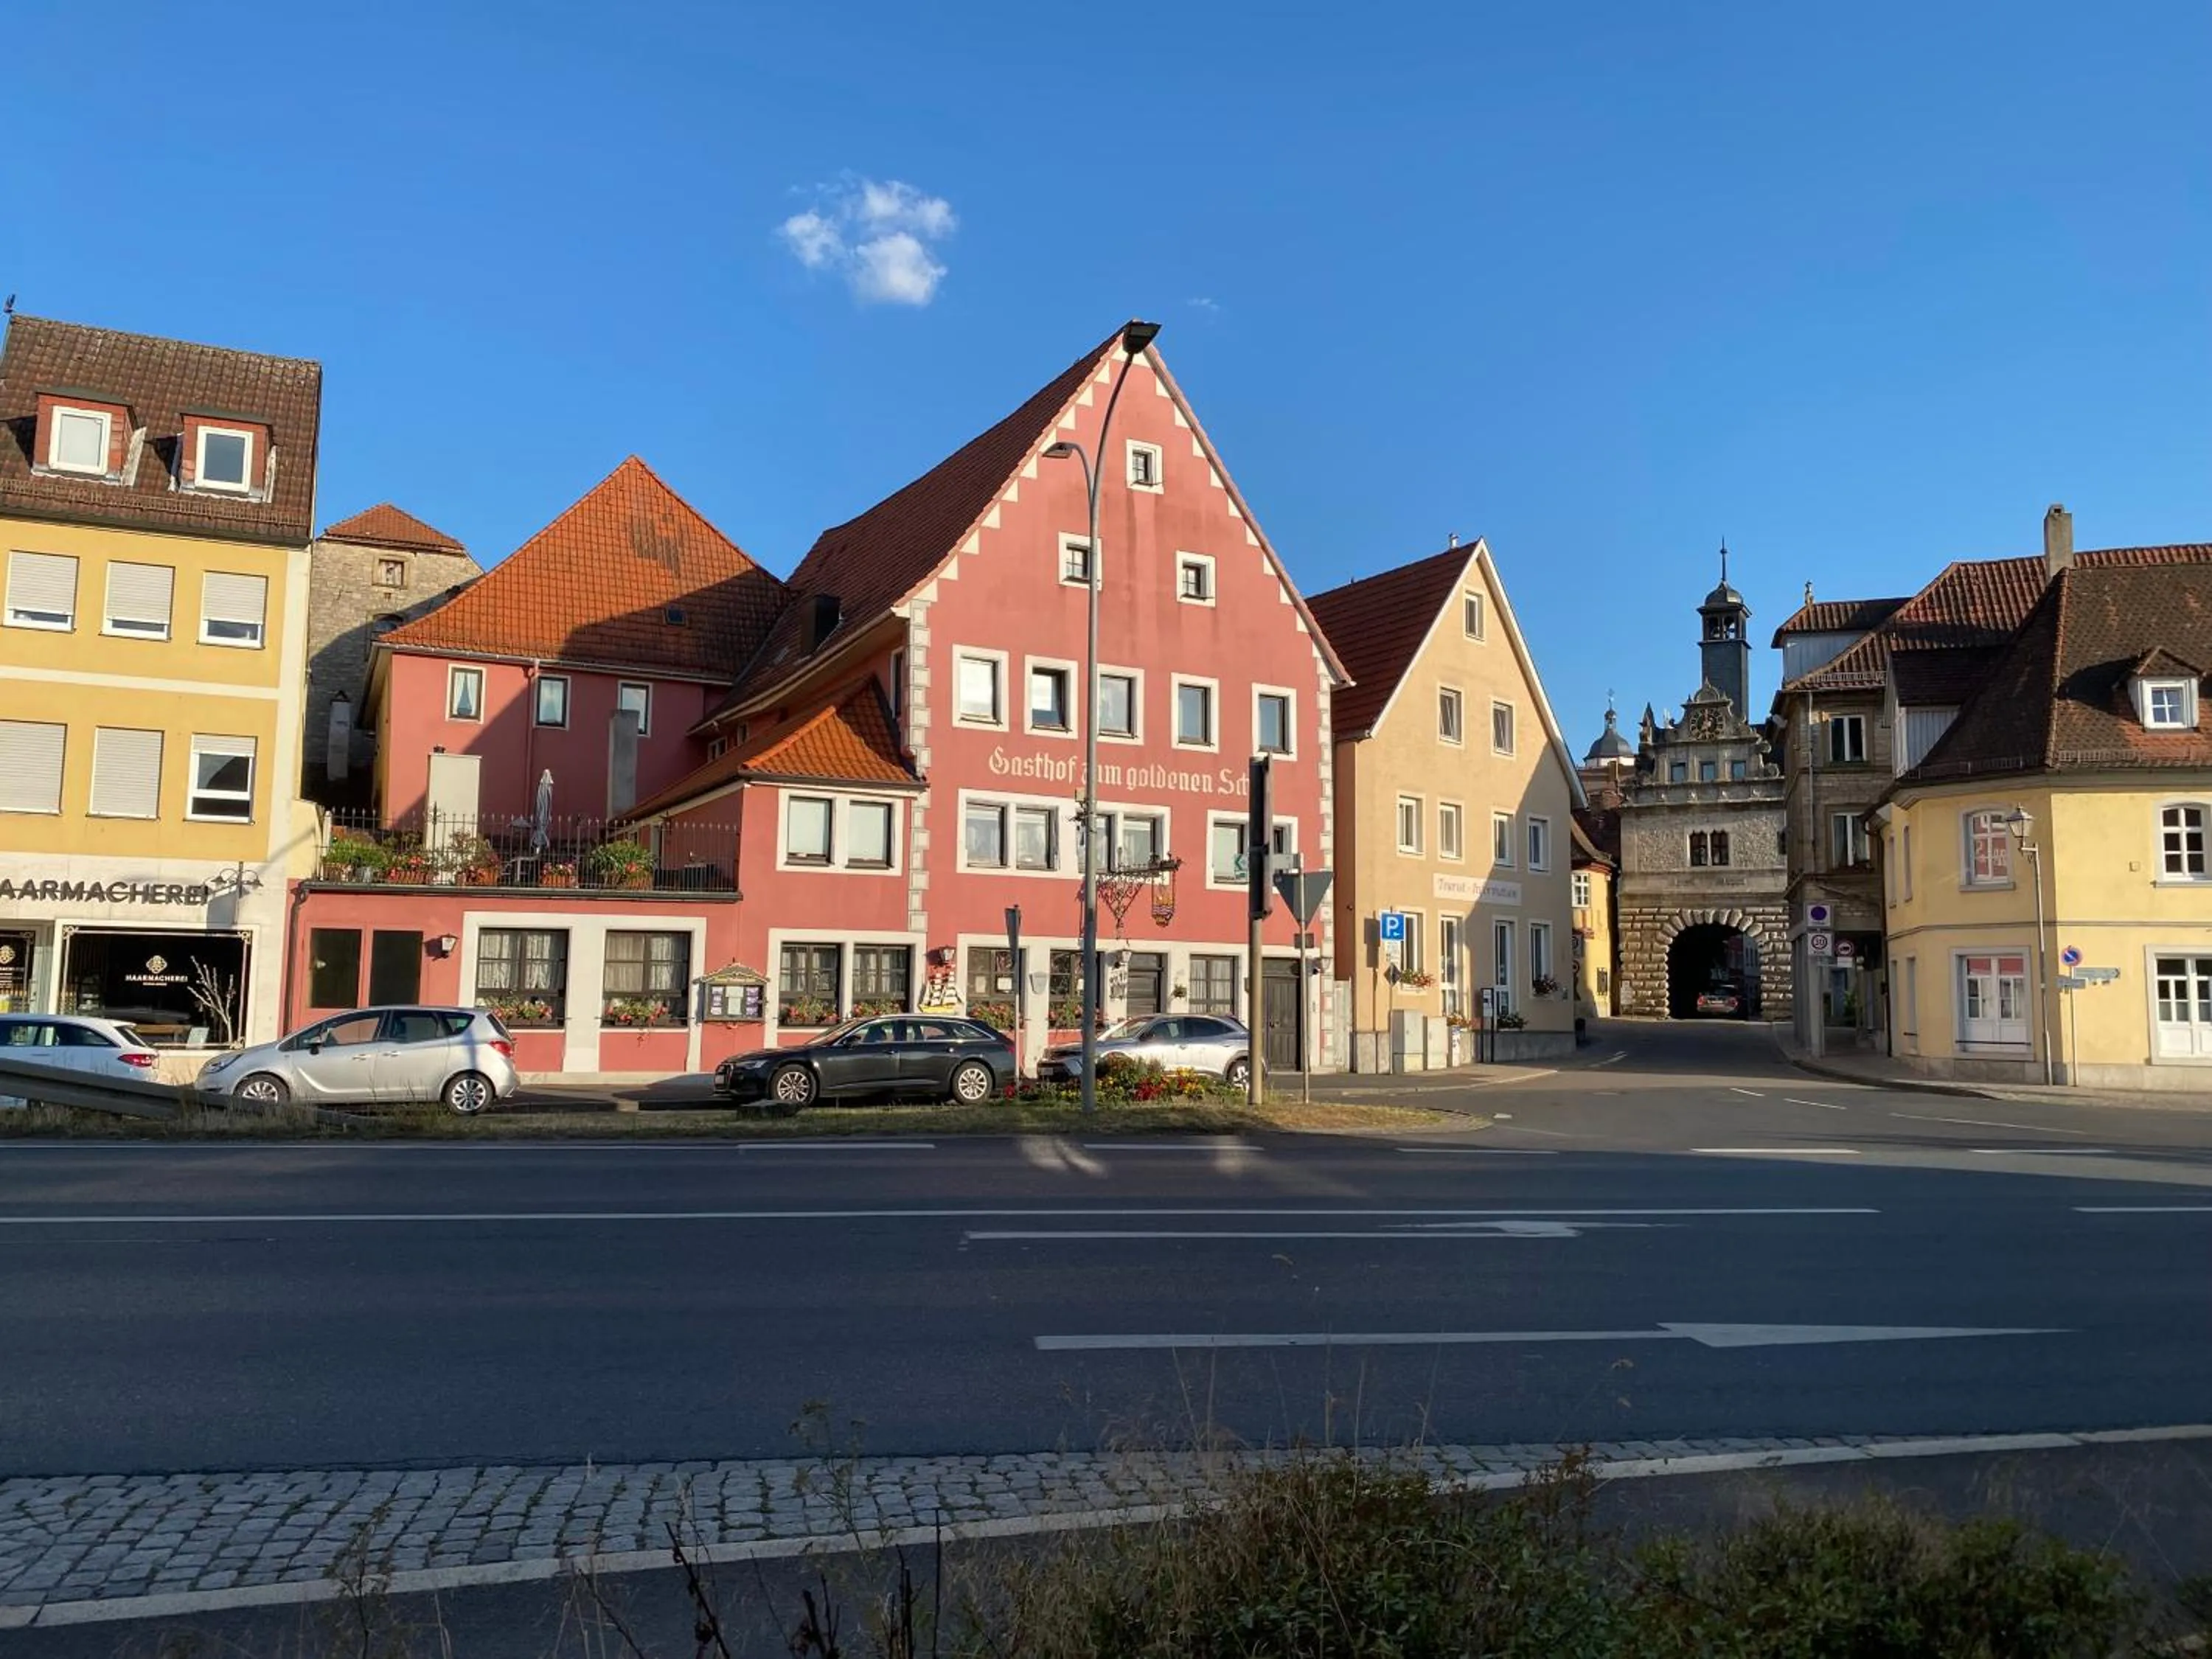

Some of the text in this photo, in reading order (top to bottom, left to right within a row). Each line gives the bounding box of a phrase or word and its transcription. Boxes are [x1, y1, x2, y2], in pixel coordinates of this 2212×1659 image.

[989, 745, 1077, 784] Gasthof
[1126, 764, 1213, 793] goldenen
[1387, 917, 1399, 936] P
[125, 975, 188, 983] HAARMACHEREI
